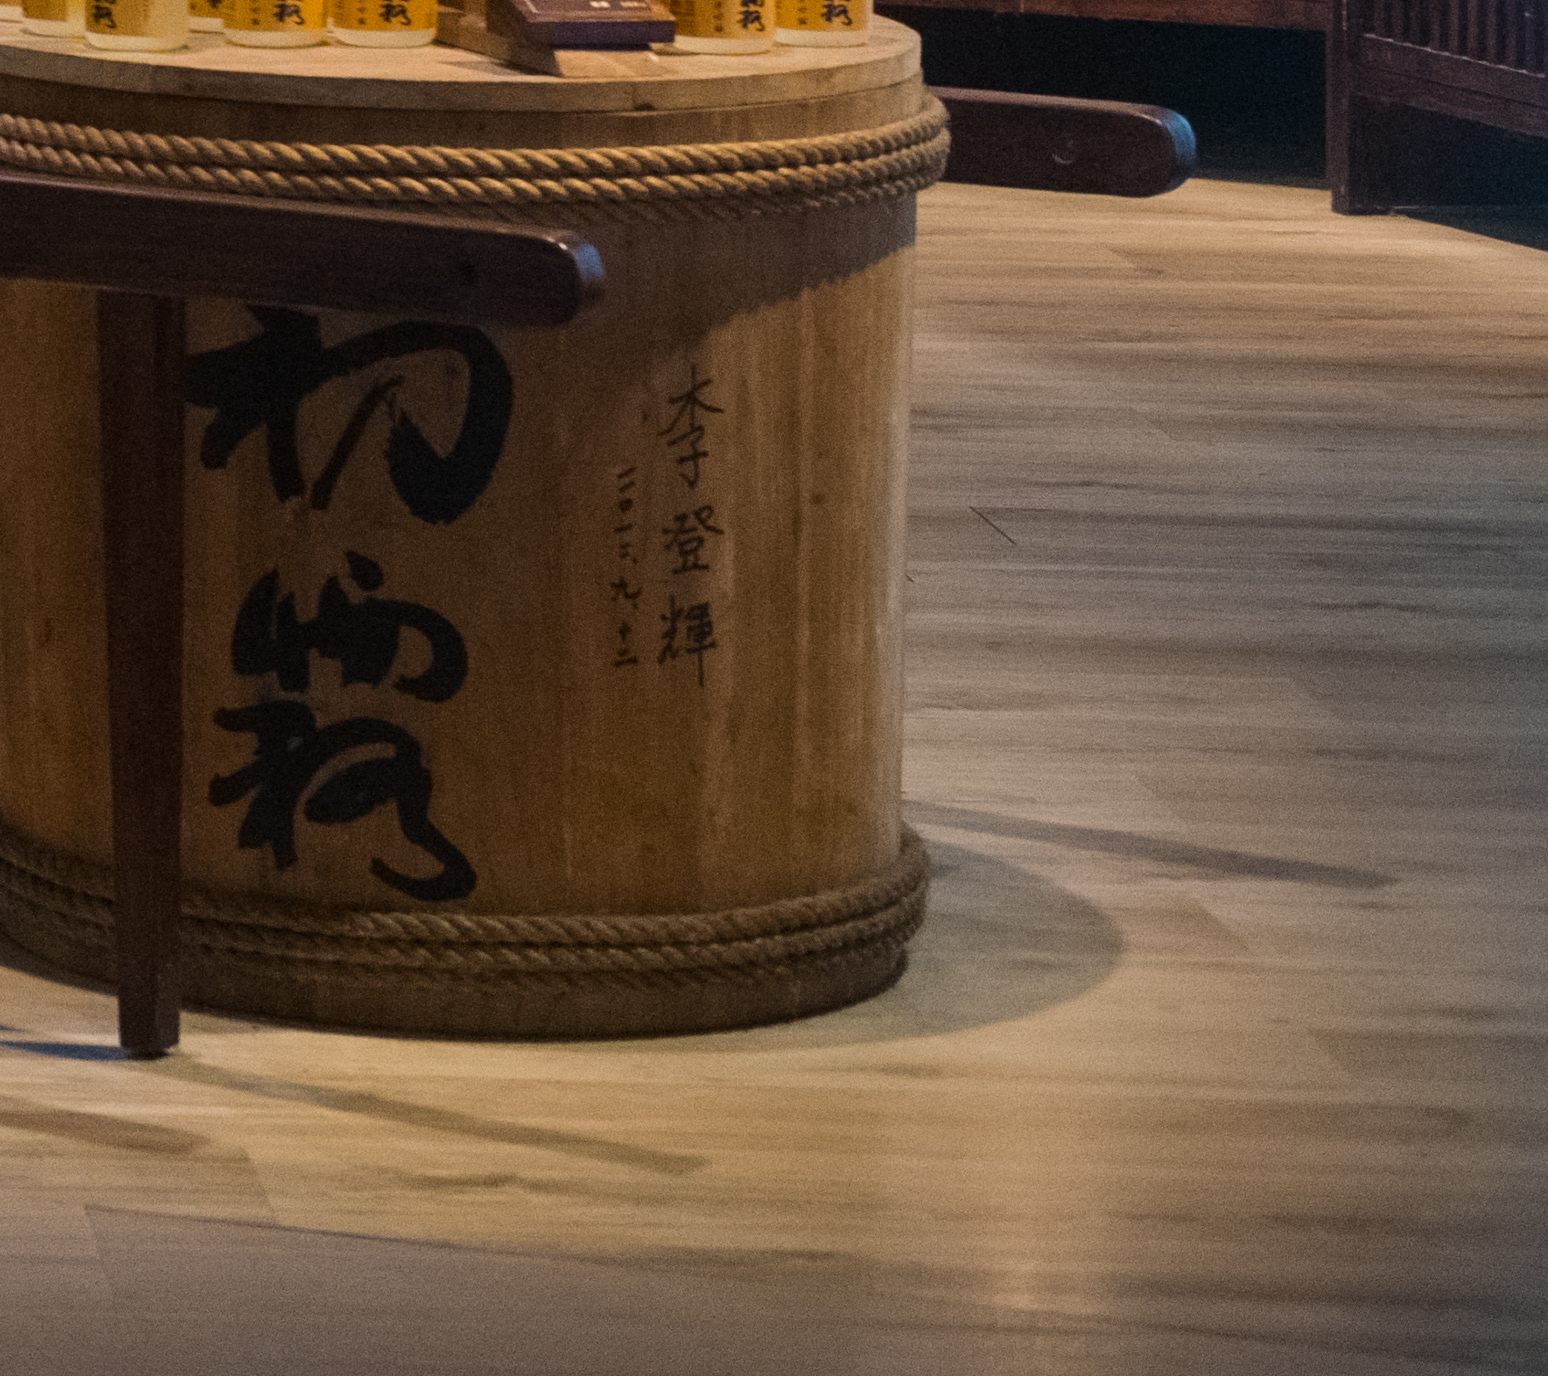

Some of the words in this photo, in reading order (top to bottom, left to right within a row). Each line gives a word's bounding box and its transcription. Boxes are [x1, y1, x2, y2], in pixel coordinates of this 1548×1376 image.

[184, 302, 514, 906] 初霧
[656, 361, 727, 688] 李登輝
